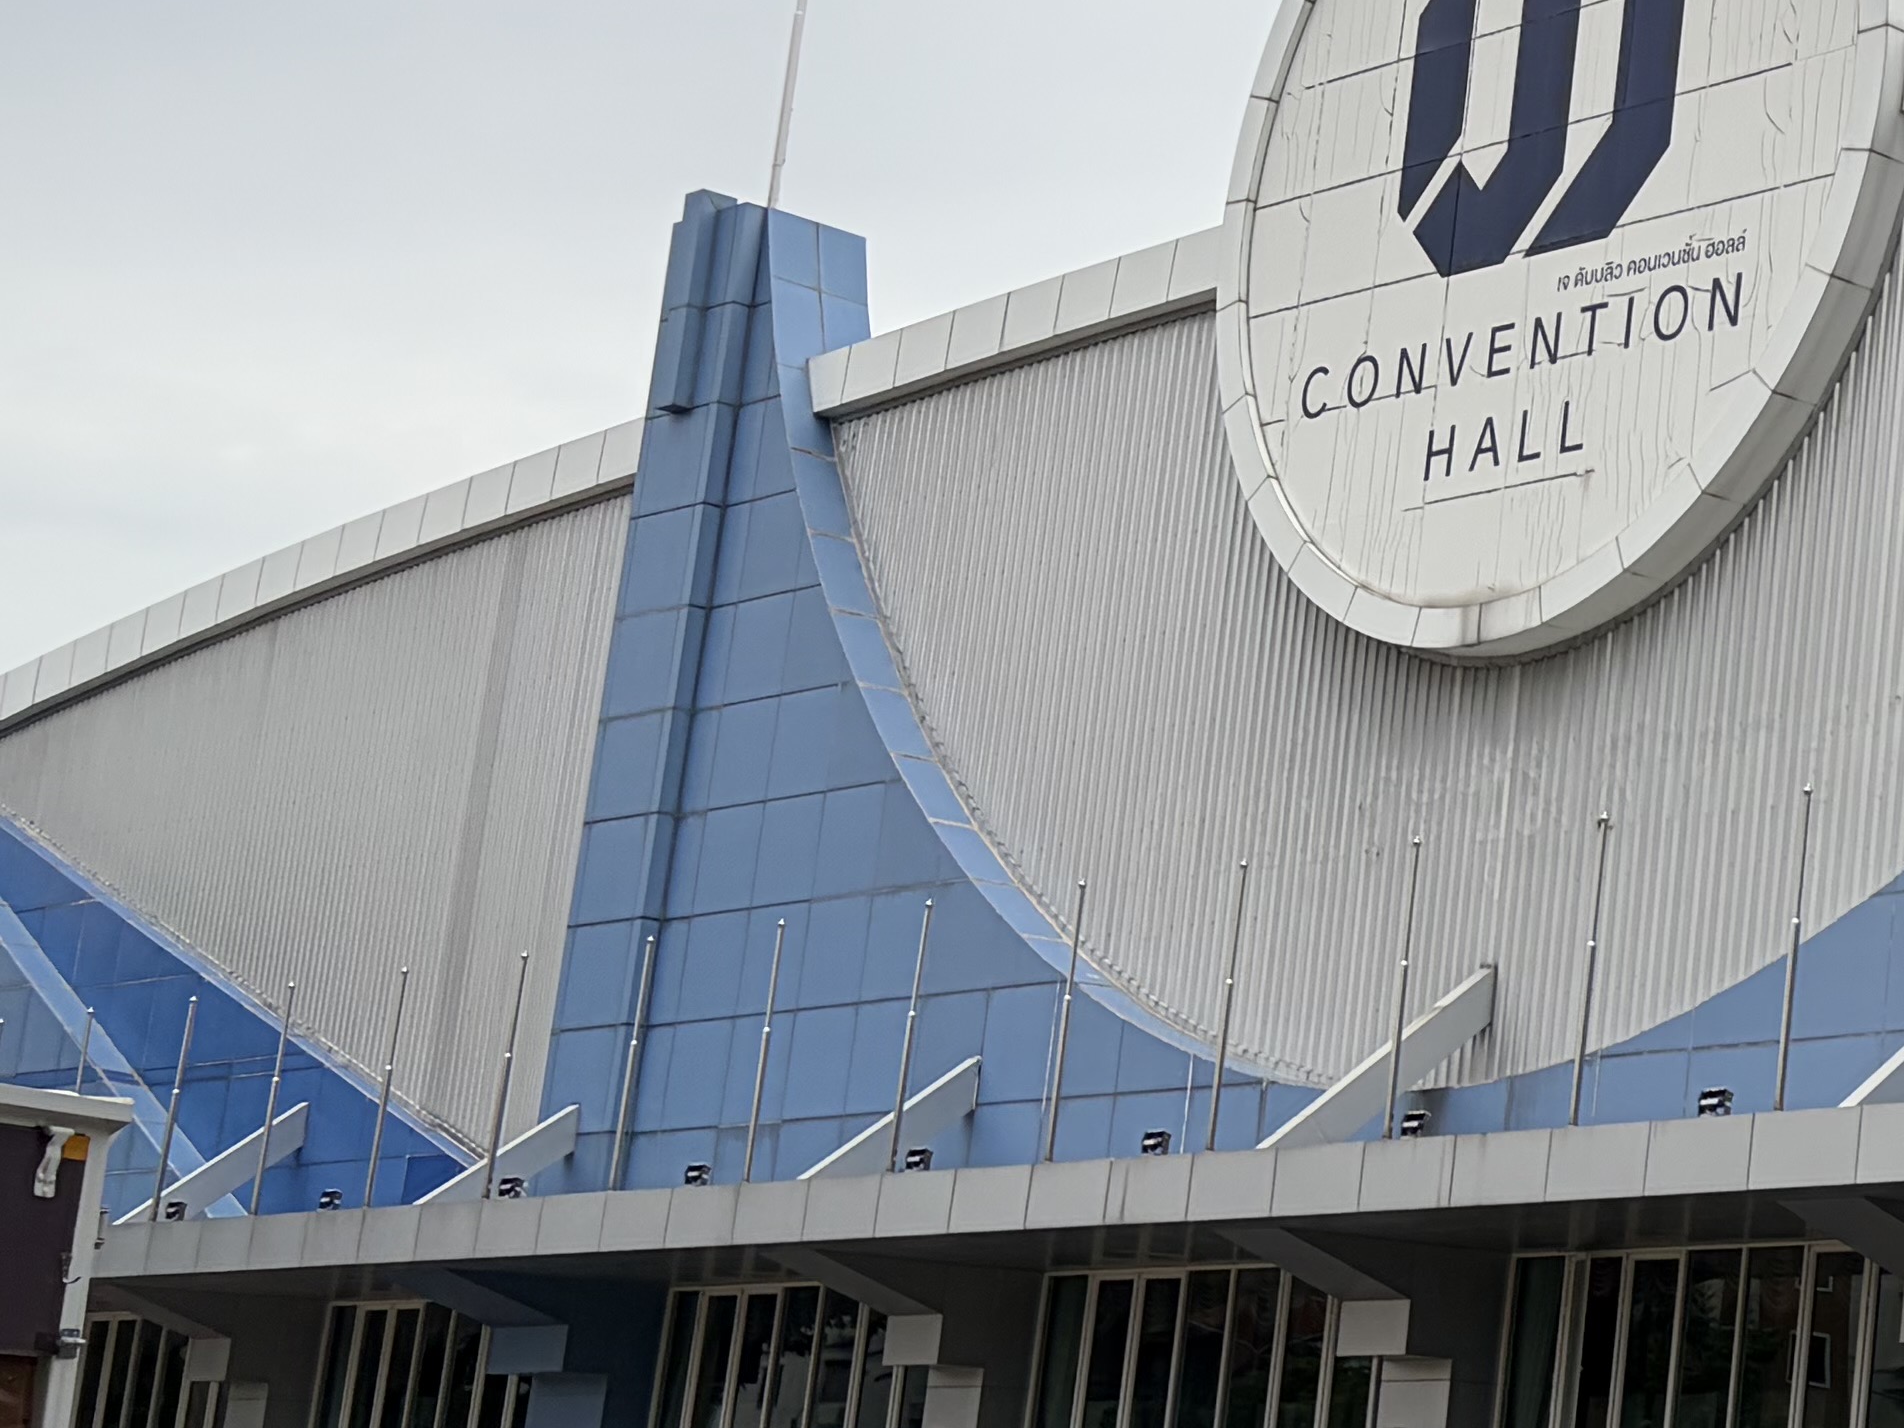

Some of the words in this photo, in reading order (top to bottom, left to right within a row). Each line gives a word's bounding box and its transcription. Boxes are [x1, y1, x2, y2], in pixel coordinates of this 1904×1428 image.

[1557, 274, 1571, 292] เจ
[1704, 228, 1747, 259] ฮอลล์
[1300, 272, 1744, 420] CONVENTION
[1422, 399, 1584, 482] HALL
